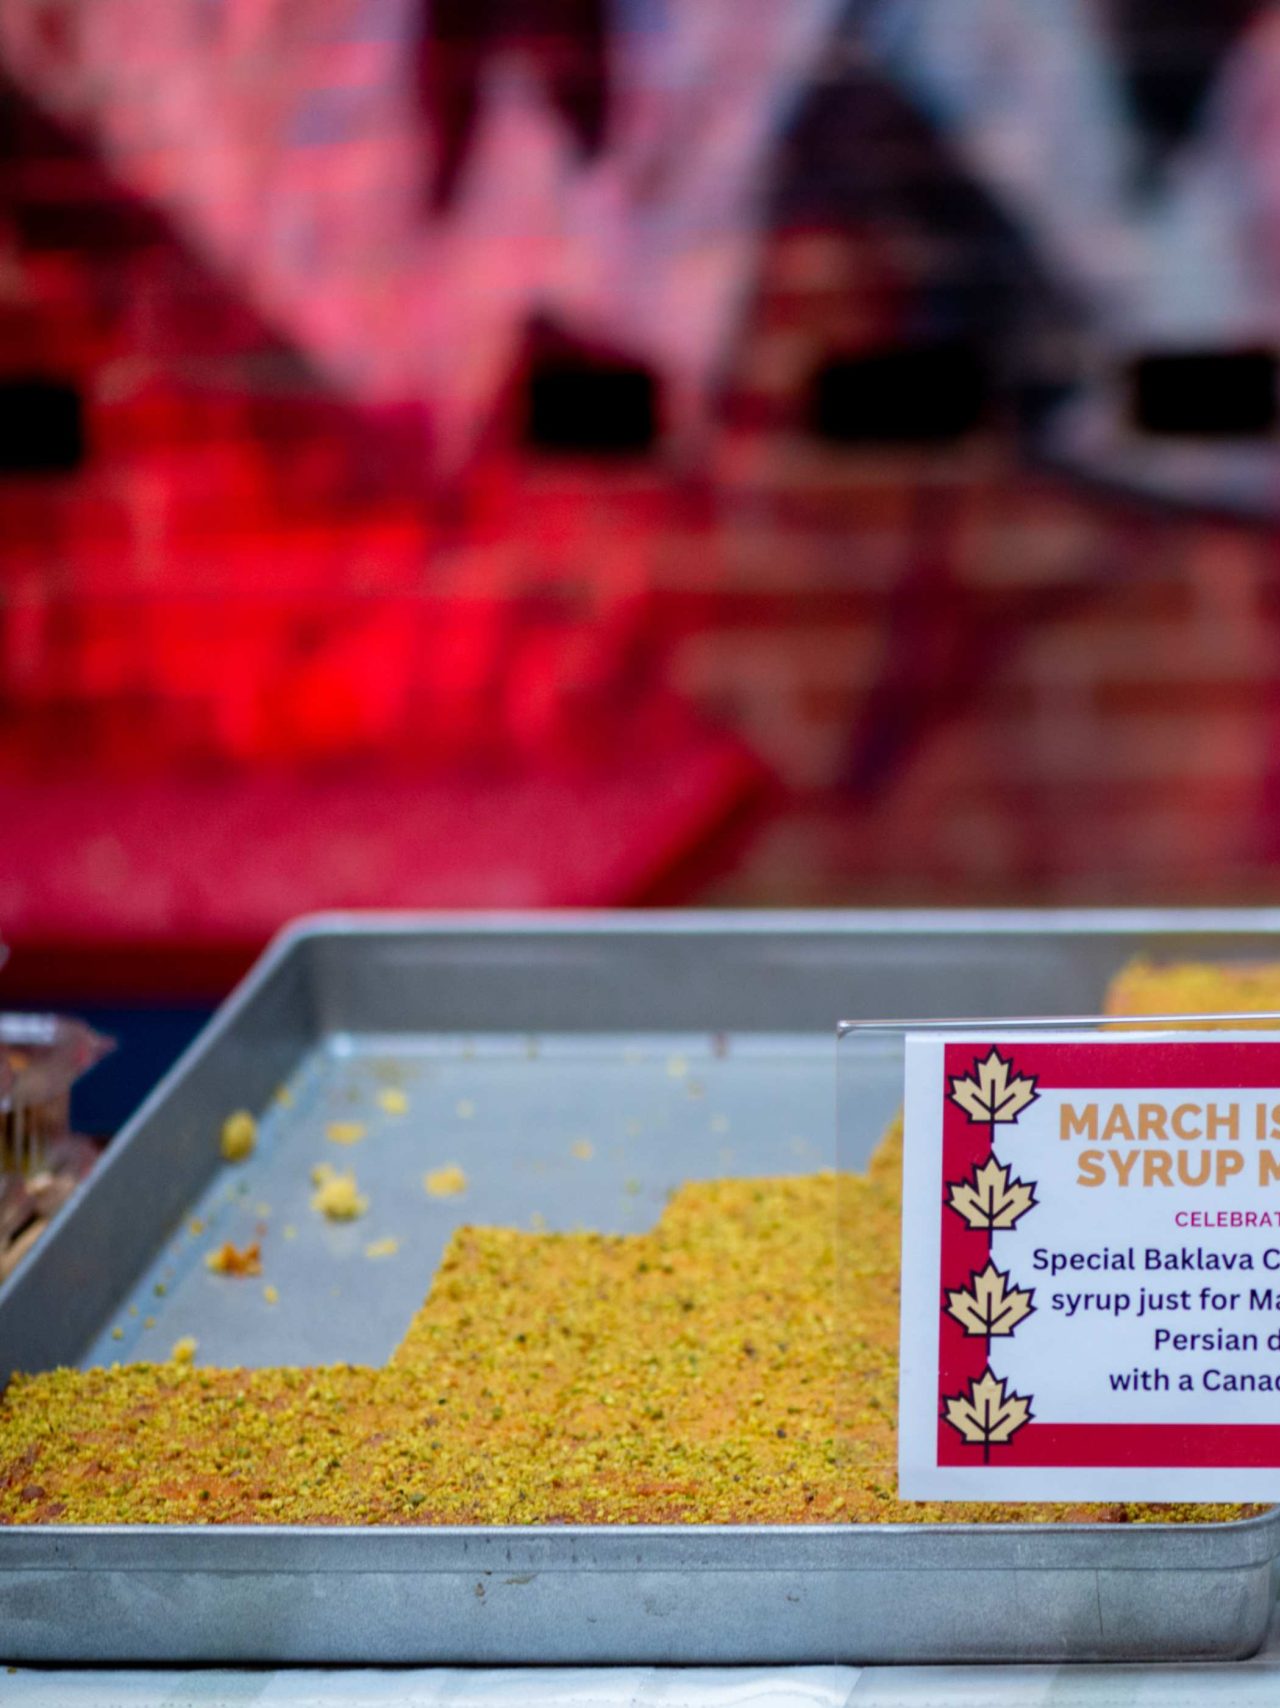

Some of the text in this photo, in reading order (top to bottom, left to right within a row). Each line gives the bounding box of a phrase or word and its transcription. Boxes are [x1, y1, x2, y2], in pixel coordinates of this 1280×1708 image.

[1059, 1103, 1240, 1141] MARCH
[1076, 1149, 1245, 1188] SYRUP
[1032, 1247, 1136, 1277] Special
[1144, 1247, 1255, 1271] Baklava
[1051, 1293, 1131, 1317] syrup
[1136, 1287, 1192, 1317] just
[1199, 1287, 1241, 1311] for
[1154, 1327, 1258, 1351] Persian
[1109, 1367, 1170, 1392] with
[1178, 1374, 1195, 1392] a
